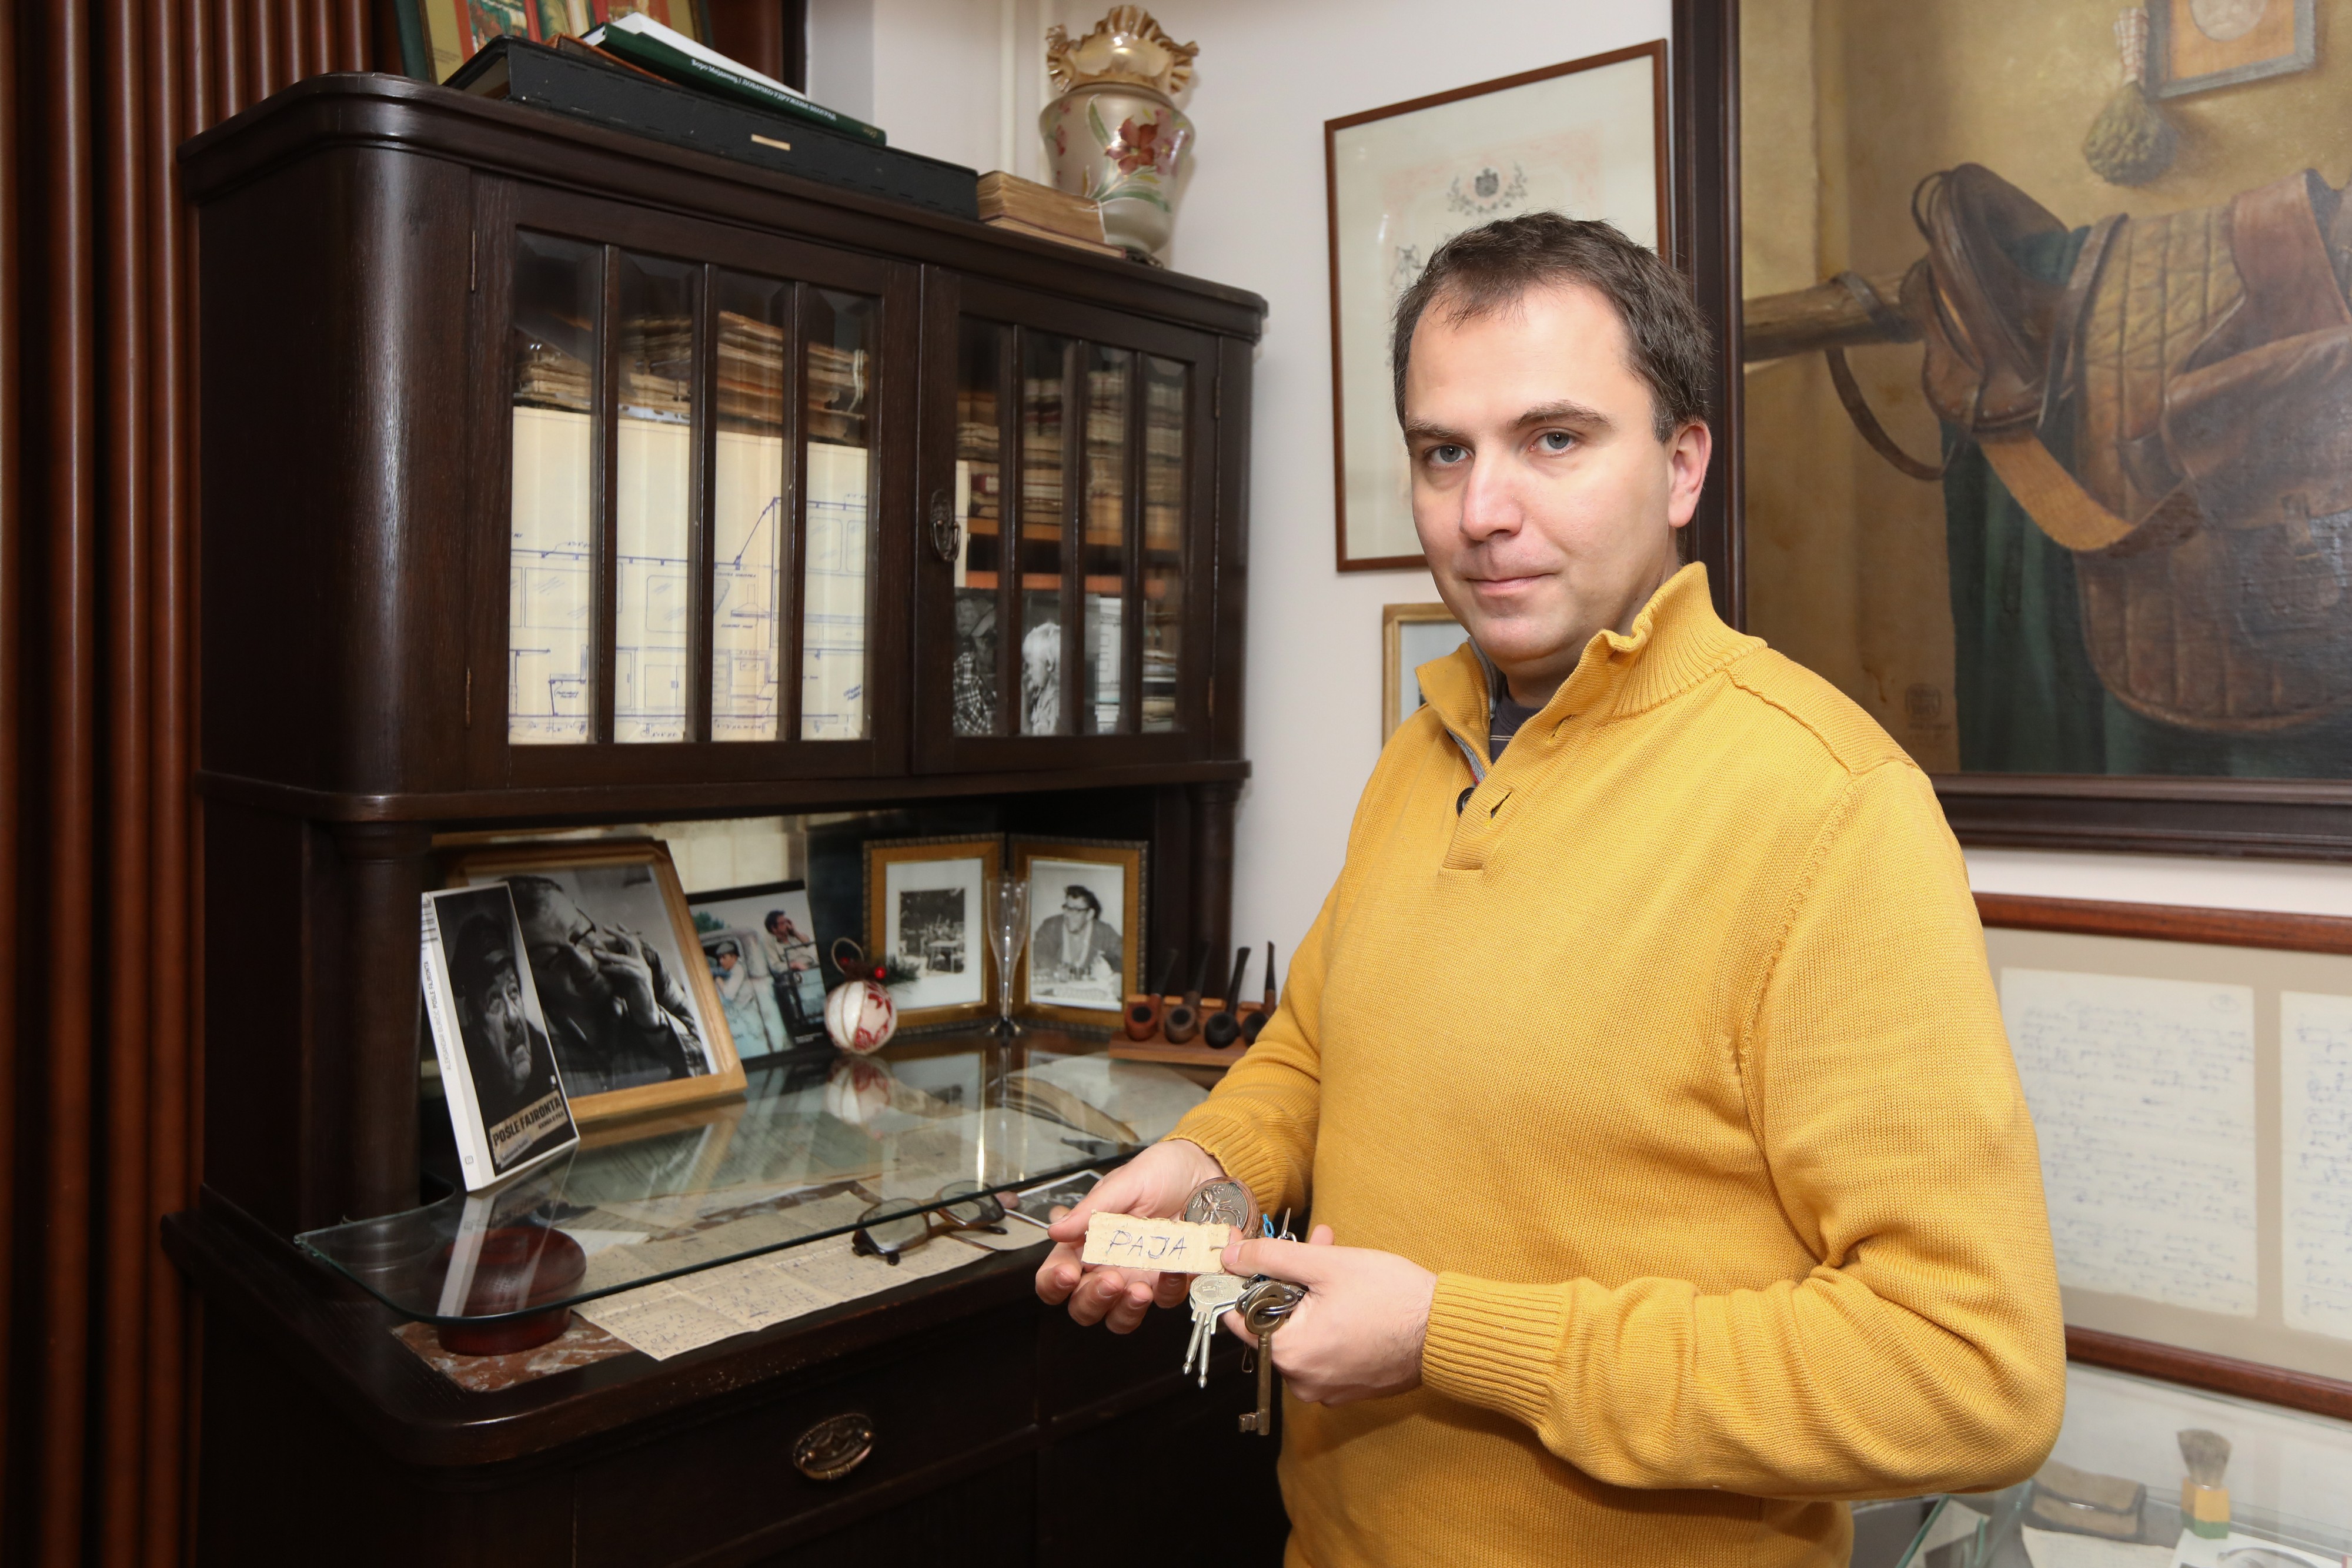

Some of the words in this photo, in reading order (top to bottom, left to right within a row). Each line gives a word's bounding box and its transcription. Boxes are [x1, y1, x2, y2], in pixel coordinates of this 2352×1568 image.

[492, 1119, 520, 1146] POSLE
[519, 1096, 562, 1129] FAJRONTA
[1106, 1230, 1187, 1259] PAJA
